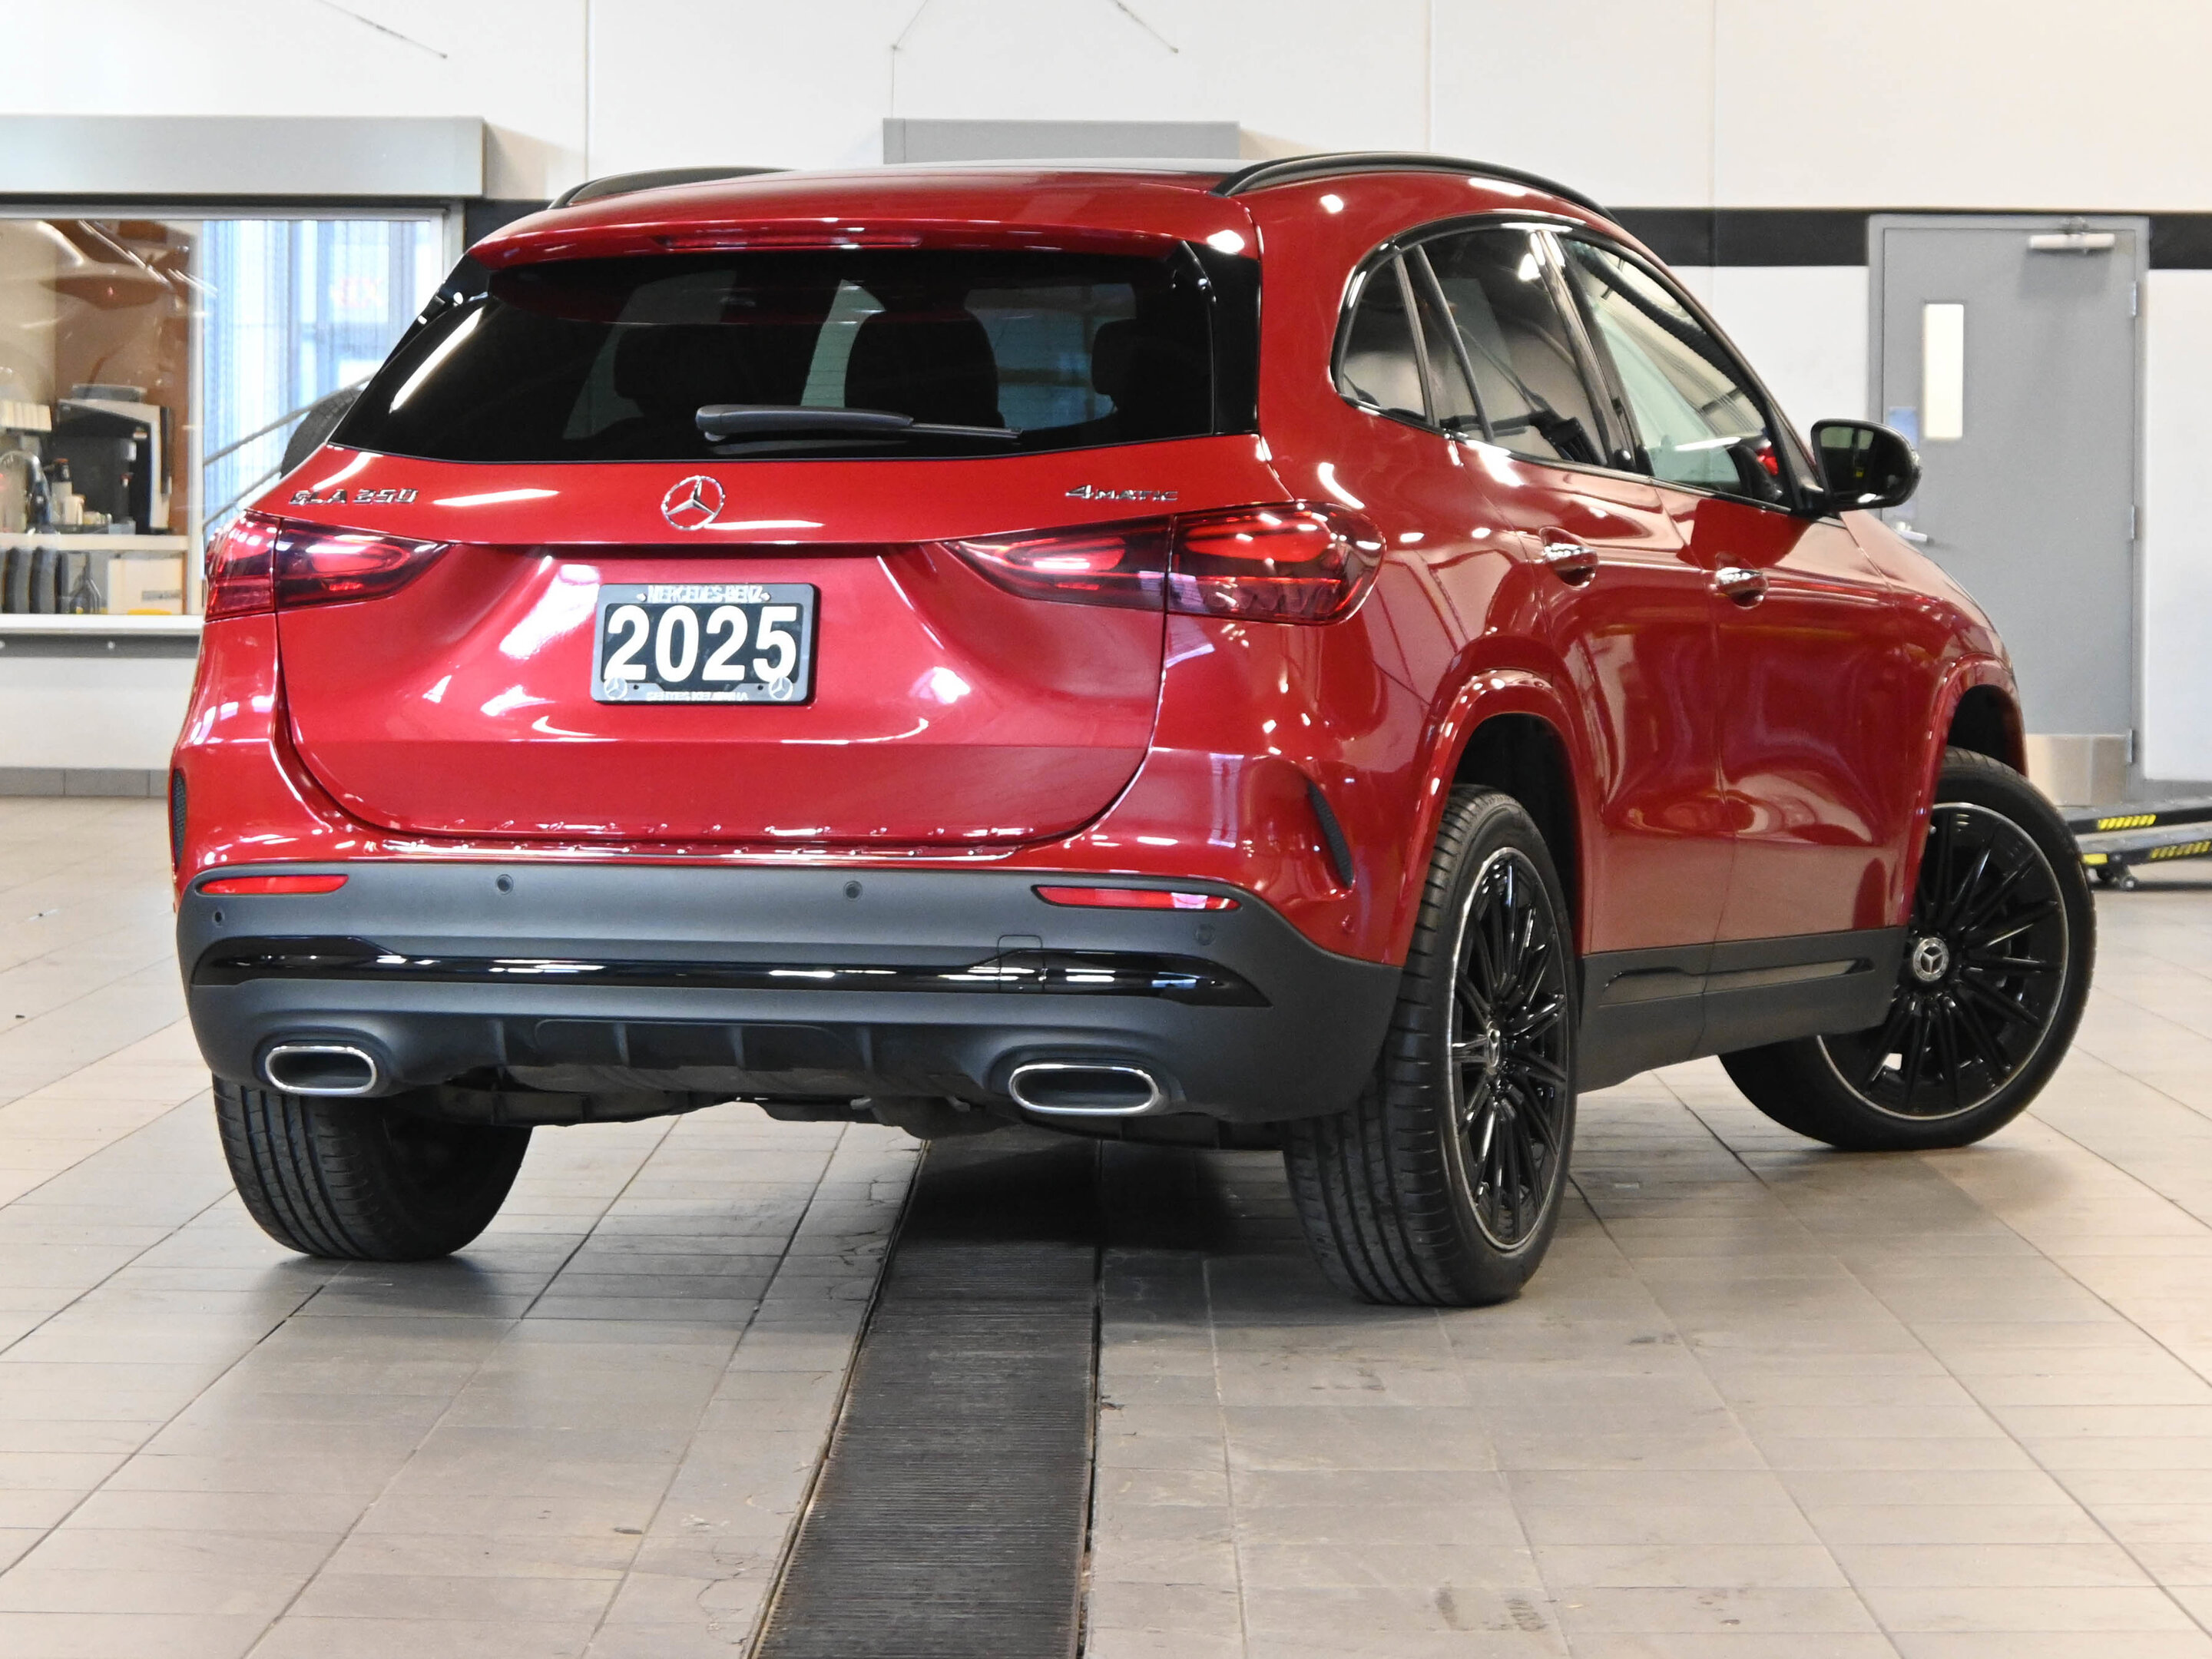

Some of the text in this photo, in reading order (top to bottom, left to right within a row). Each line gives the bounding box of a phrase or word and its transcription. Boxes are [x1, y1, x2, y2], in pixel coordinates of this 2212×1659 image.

[1065, 485, 1177, 501] 4MATIC
[647, 584, 763, 603] MERCEDES-BENZ
[604, 604, 797, 683] 2025
